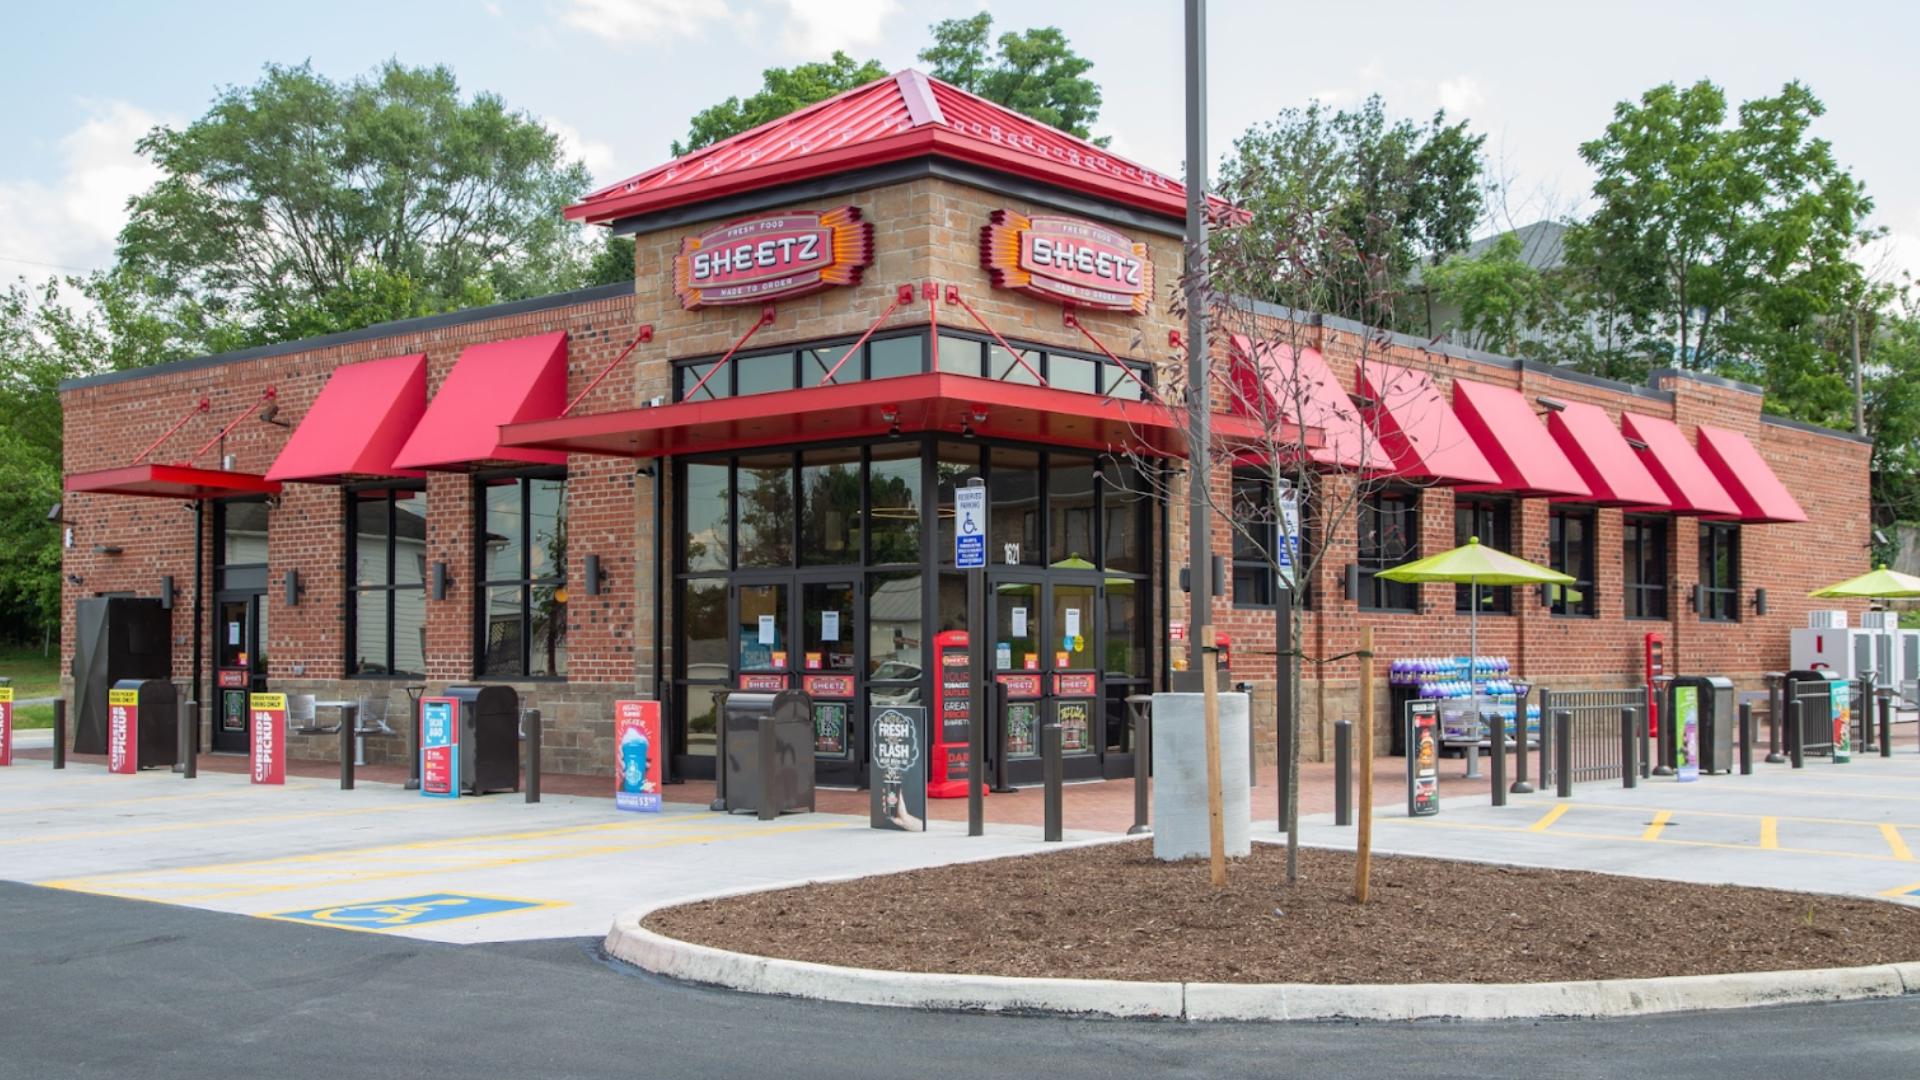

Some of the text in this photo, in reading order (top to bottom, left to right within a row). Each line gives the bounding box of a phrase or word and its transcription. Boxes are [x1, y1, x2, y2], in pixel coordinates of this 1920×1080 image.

[727, 219, 784, 238] FRESH FOOD
[1062, 225, 1112, 243] FRESH FOOD
[694, 233, 819, 279] SHEETZ
[1032, 237, 1141, 286] SHEETZ
[720, 277, 793, 297] MADE TO ORDER
[1054, 283, 1116, 300] MADE TO ORDER
[958, 492, 983, 500] RESERVED
[960, 501, 980, 509] PARKING
[1004, 542, 1020, 565] 1621
[748, 681, 780, 689] SHEETZ
[811, 681, 845, 690] SHEETZ
[1060, 681, 1088, 689] SHEETZ
[944, 701, 970, 711] GREAT
[118, 707, 127, 754] PICKUP
[263, 711, 273, 763] PICKUP
[879, 723, 910, 738] FRESH
[255, 711, 264, 782] CURBSIDE
[879, 743, 910, 758] FLASH
[948, 752, 970, 762] DAR
